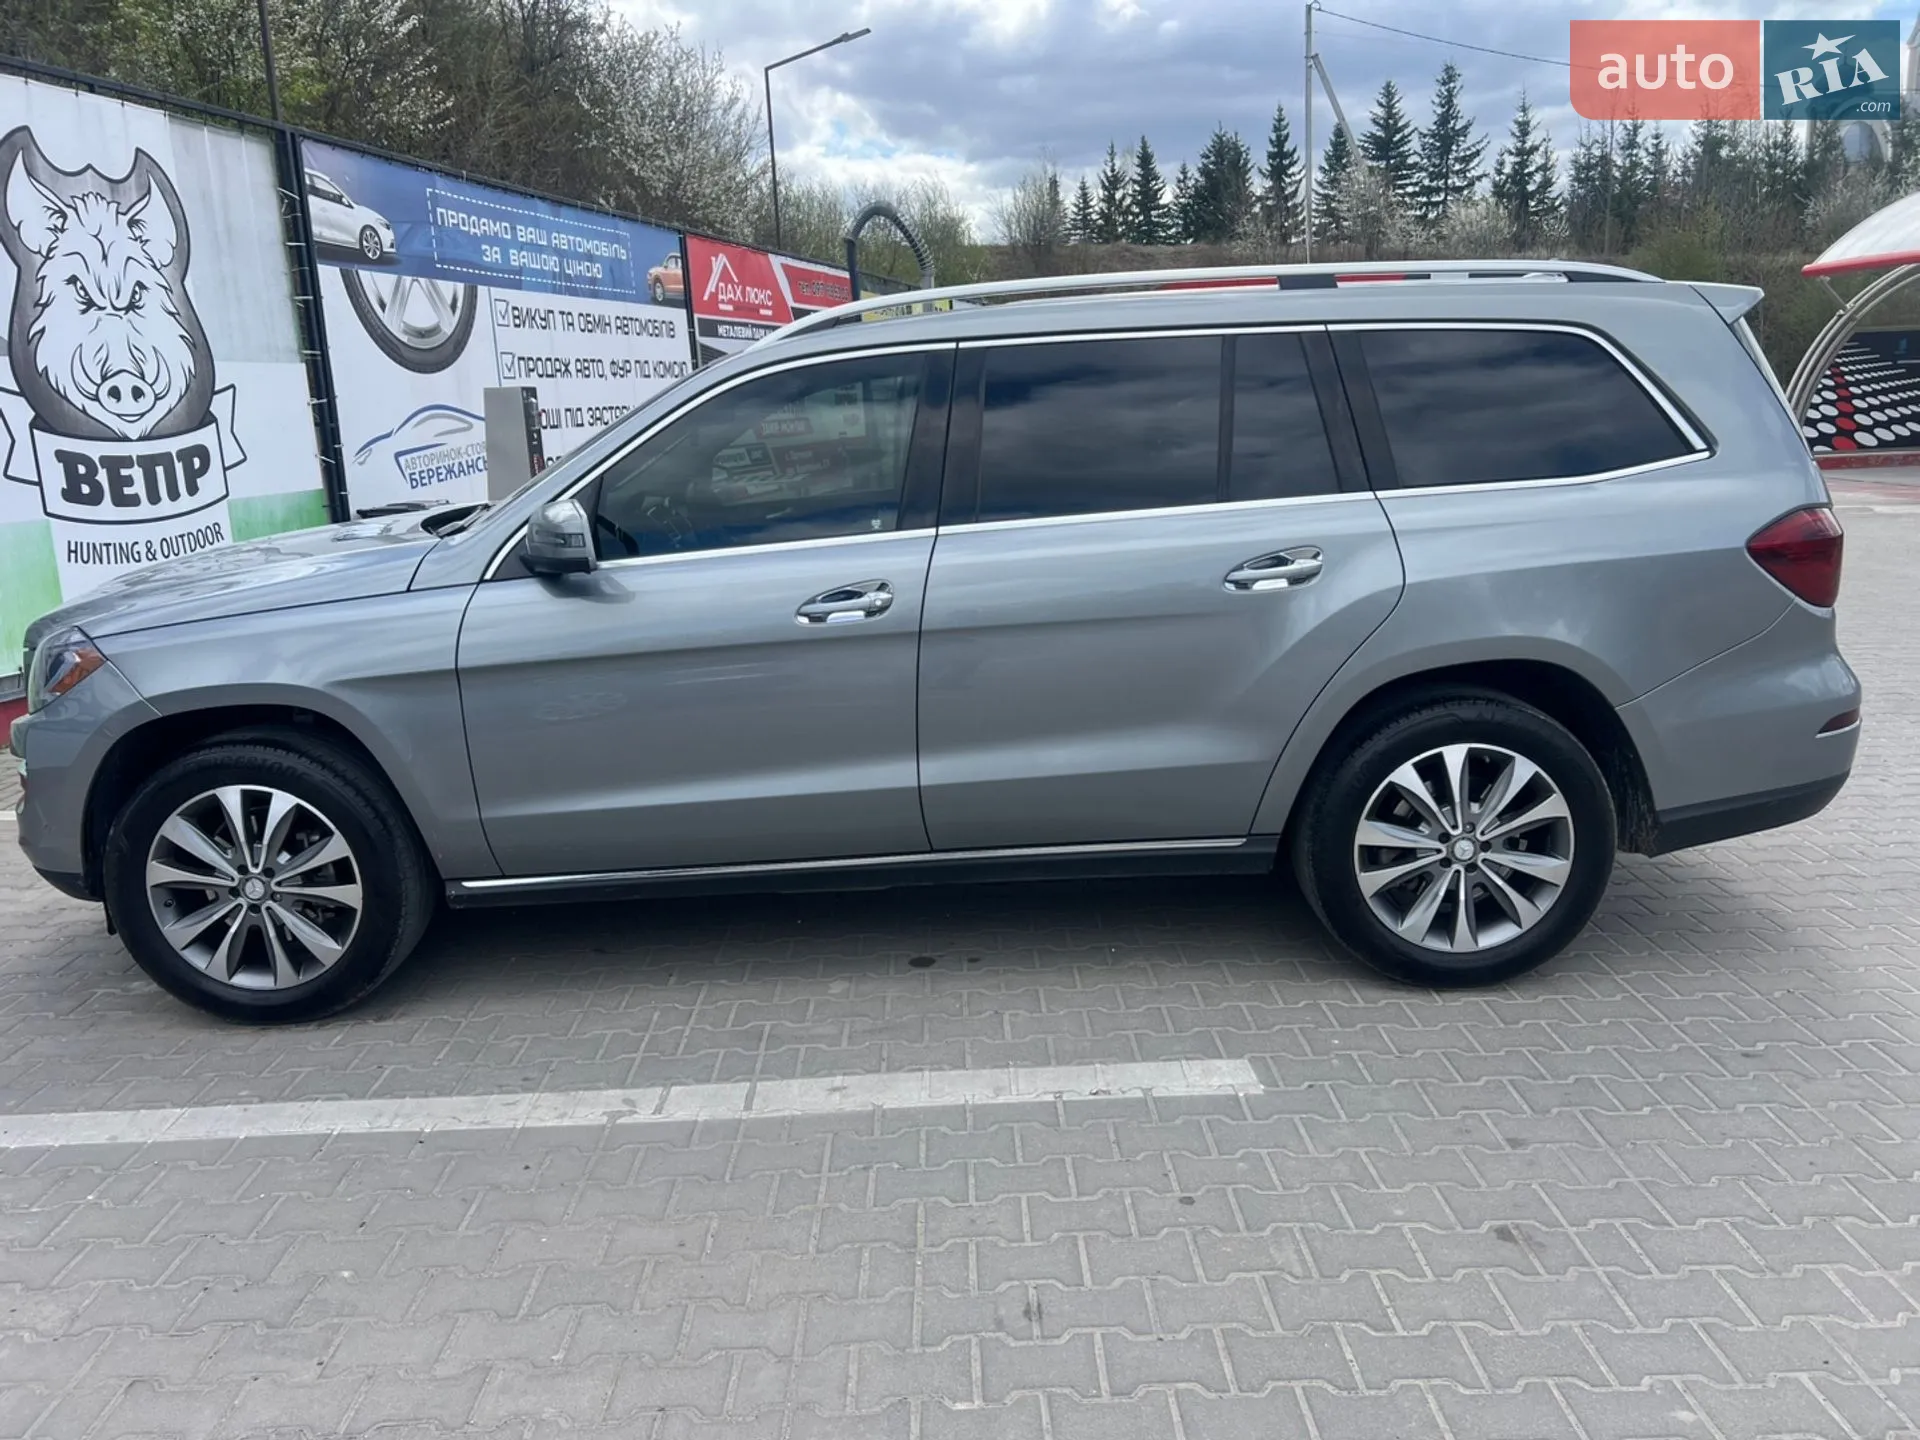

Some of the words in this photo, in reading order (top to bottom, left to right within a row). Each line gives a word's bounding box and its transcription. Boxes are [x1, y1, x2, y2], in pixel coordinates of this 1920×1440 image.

[436, 207, 511, 239] ПРОДАМО
[516, 225, 548, 246] ВАШ
[551, 232, 627, 260] АВТОМОБІЛЬ
[481, 244, 502, 263] ЗА
[509, 249, 560, 272] ВАШОЮ
[563, 258, 603, 278] ЦІНОЮ
[718, 282, 743, 303] ДАХ
[745, 286, 773, 307] ЛЮКС
[511, 306, 556, 330] ВИКУП
[559, 311, 575, 332] ТА
[578, 313, 612, 335] ОБМІН
[615, 316, 676, 338] АВТОМОБІЛІВ
[517, 356, 572, 378] ПРОДАЖ
[575, 358, 608, 381] АВТО,
[610, 358, 631, 379] ФУР
[634, 360, 651, 379] ПІД
[564, 407, 585, 428] ПІД
[54, 443, 211, 508] ВЕПР
[67, 540, 141, 565] HUNTING
[145, 540, 158, 562] &
[160, 522, 225, 559] OUTDOOR
